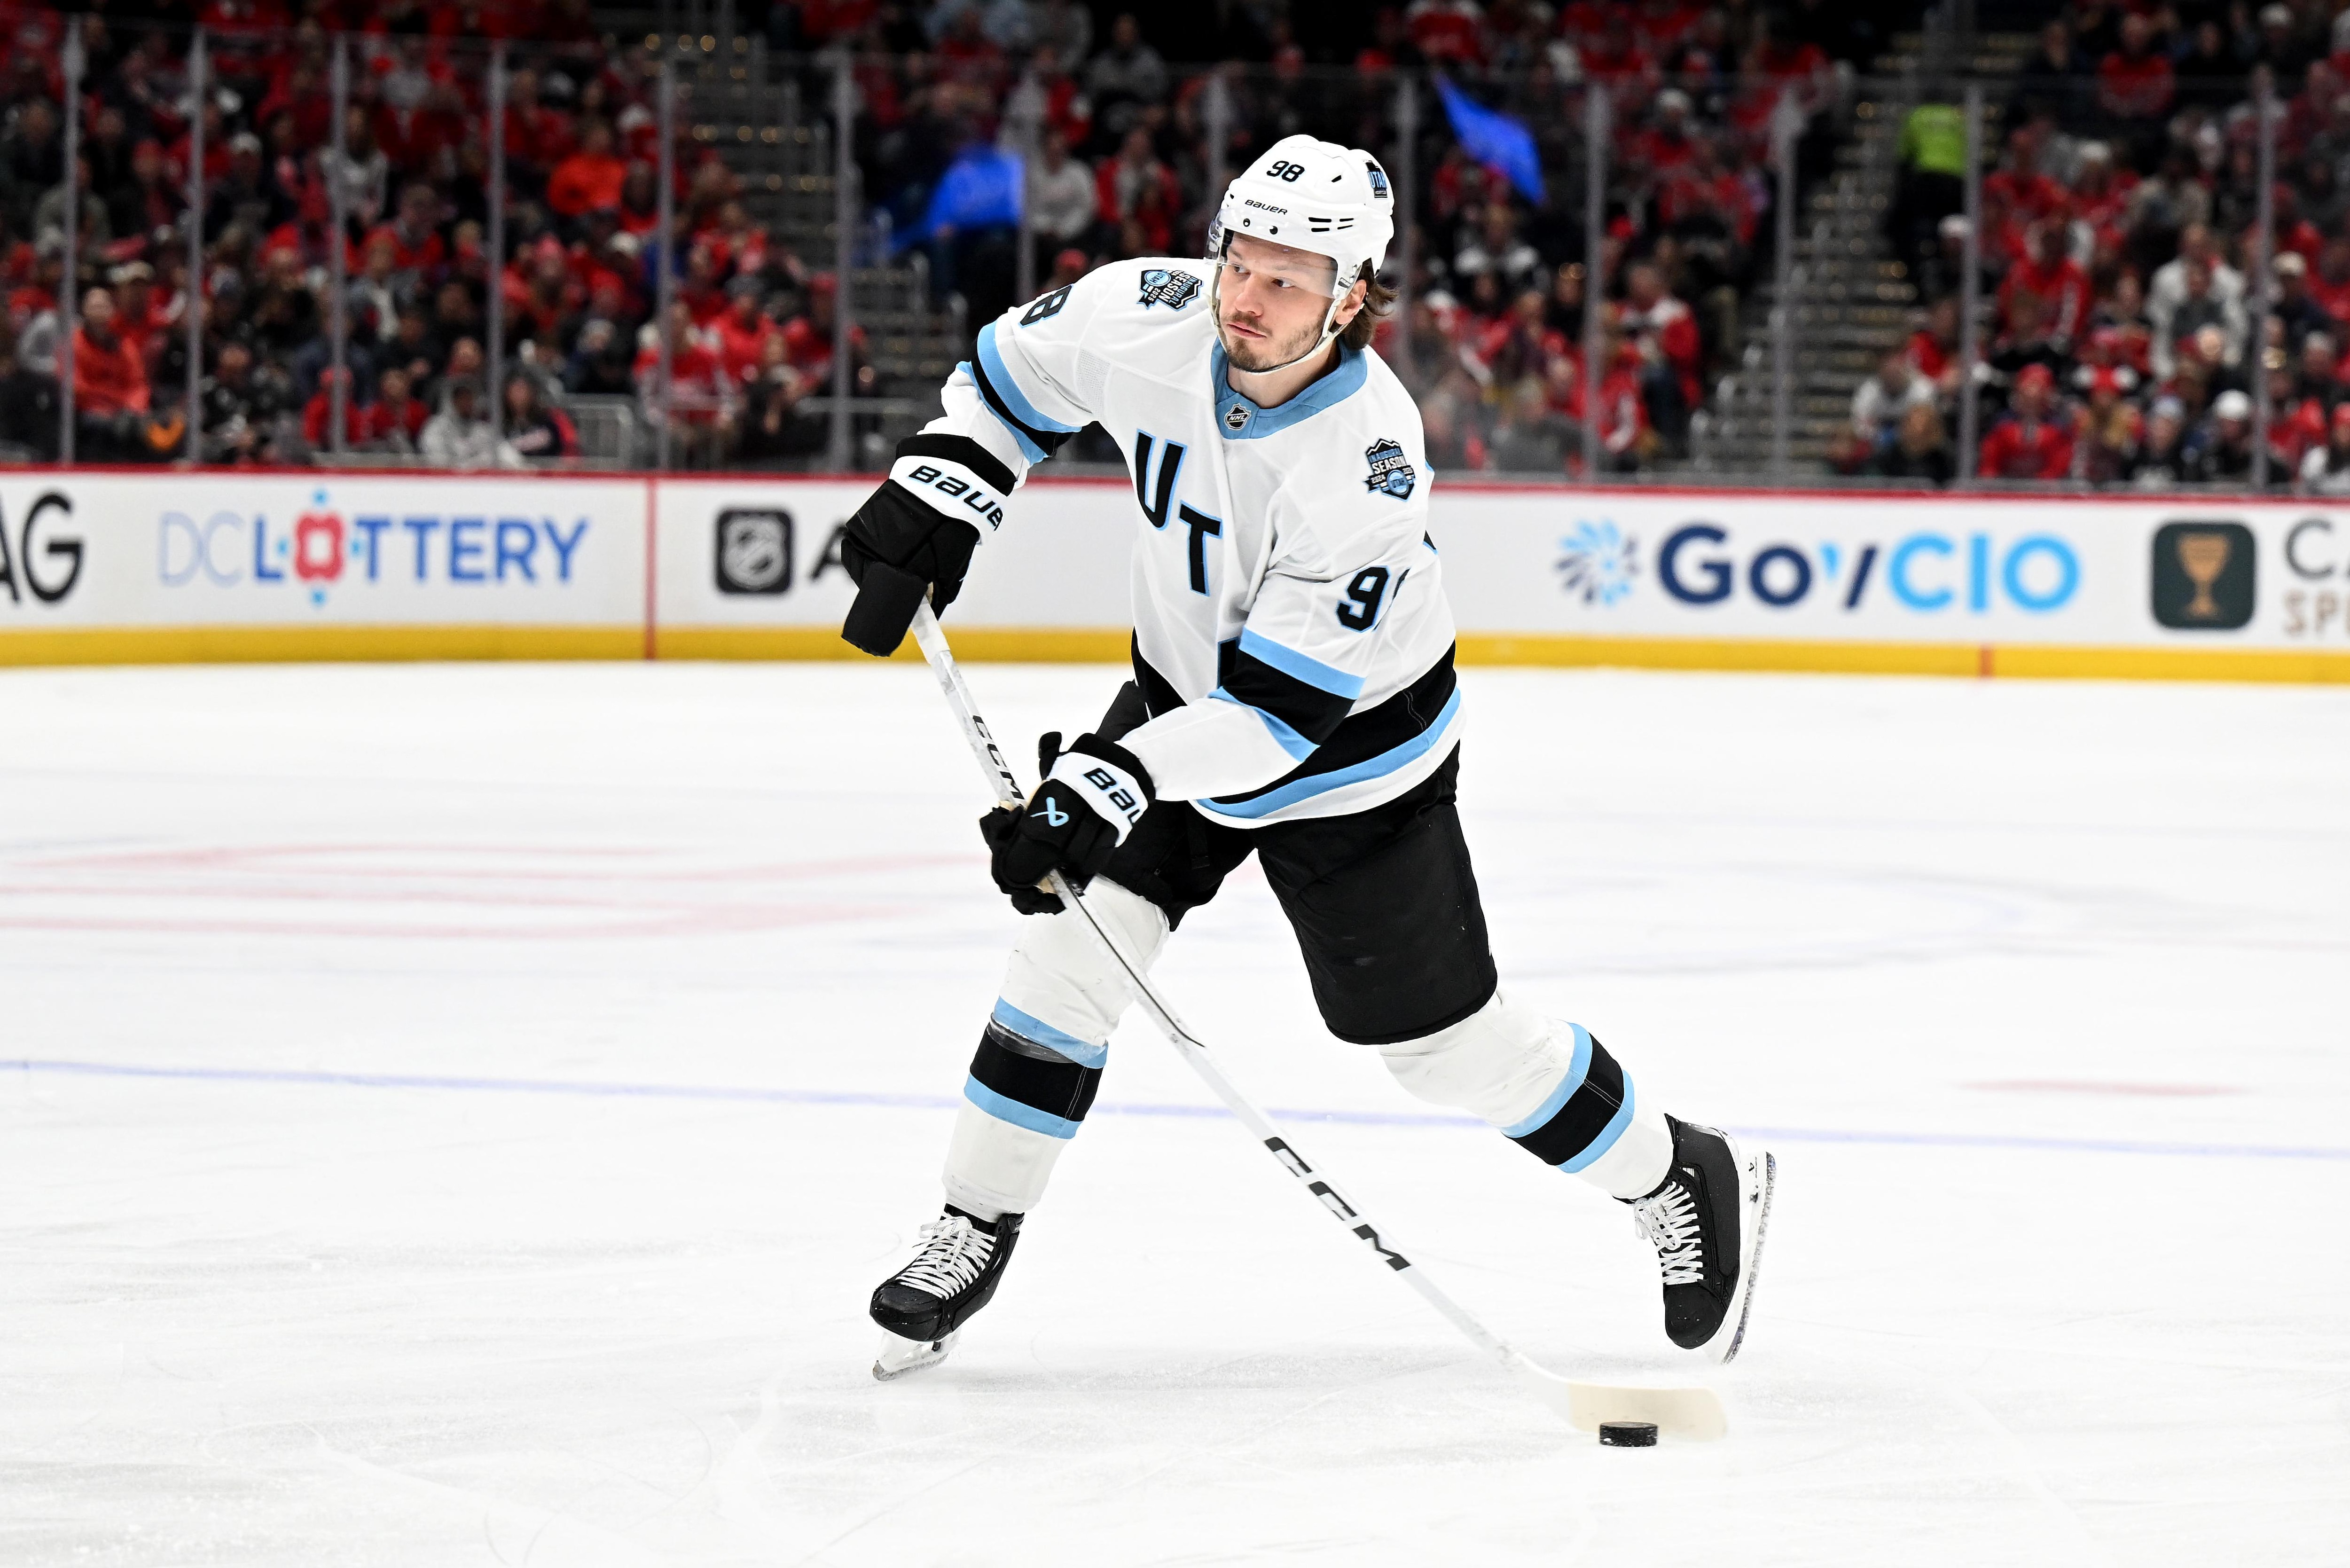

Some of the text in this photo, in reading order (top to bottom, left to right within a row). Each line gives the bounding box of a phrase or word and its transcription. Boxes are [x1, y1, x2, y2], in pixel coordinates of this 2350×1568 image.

[1266, 160, 1305, 182] 98
[1158, 272, 1191, 303] SEASON
[1168, 277, 1198, 304] INAUGURAL
[908, 465, 1003, 531] BAUE
[2286, 517, 2350, 583] C
[2285, 590, 2350, 634] SP
[972, 715, 1025, 800] CCM
[1264, 1136, 1411, 1271] CCM
